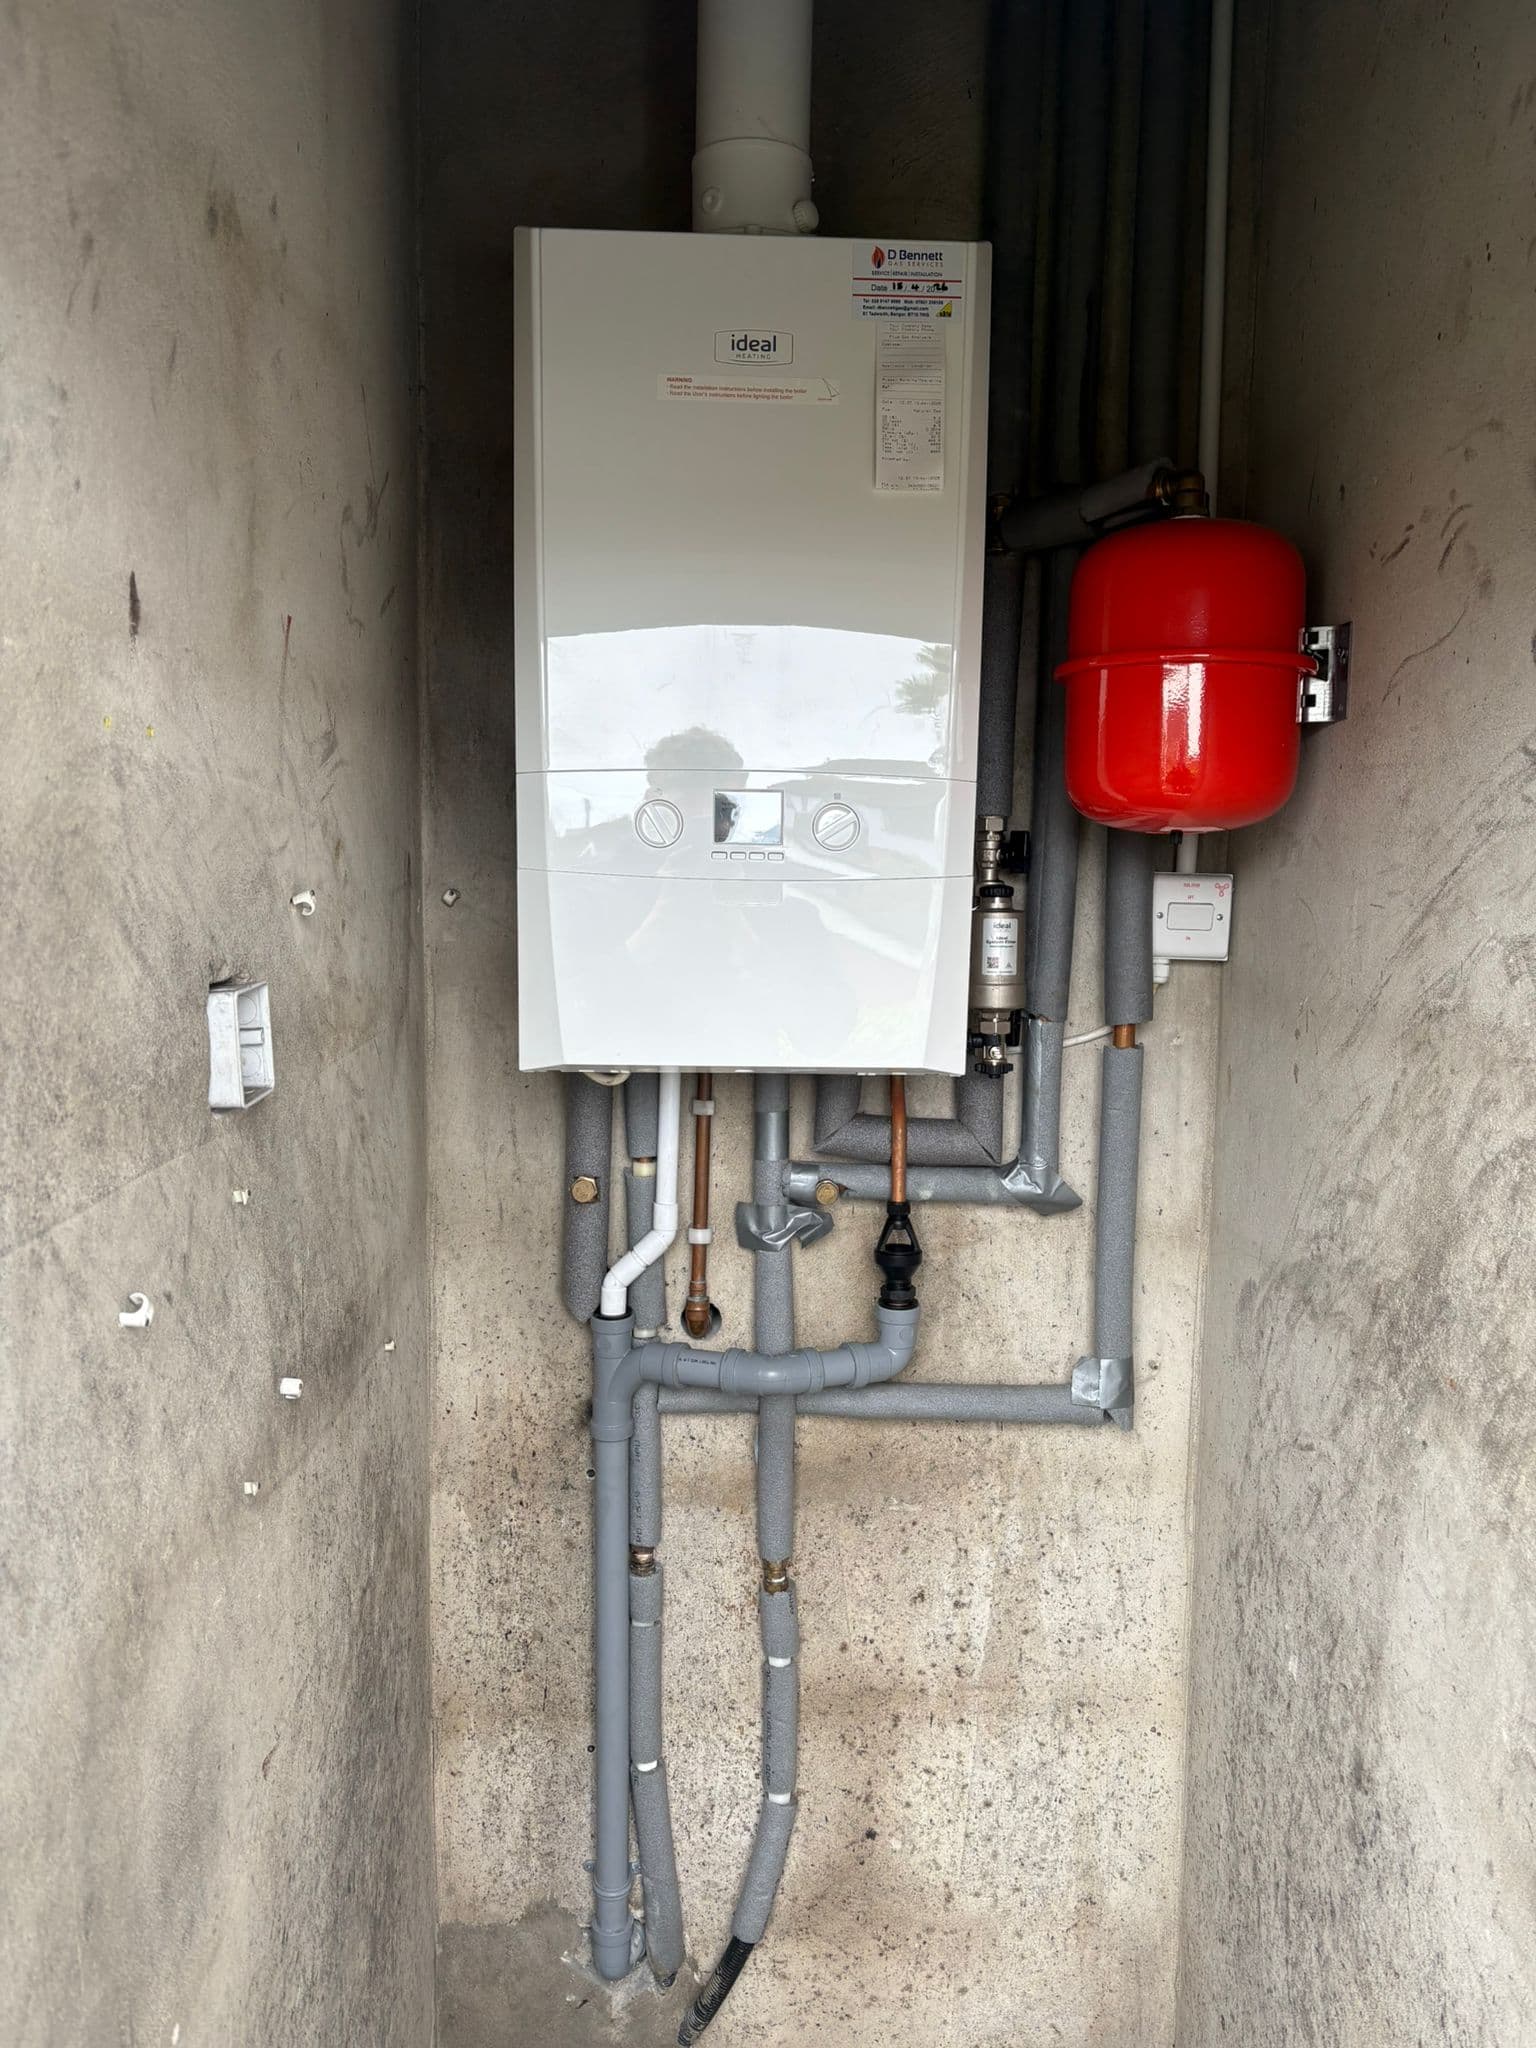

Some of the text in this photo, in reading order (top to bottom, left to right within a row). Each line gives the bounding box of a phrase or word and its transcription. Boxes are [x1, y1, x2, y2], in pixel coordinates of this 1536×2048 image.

[887, 249, 943, 261] D Bennett
[871, 283, 888, 291] Date
[731, 334, 776, 352] ideal
[993, 921, 1011, 929] ideal
